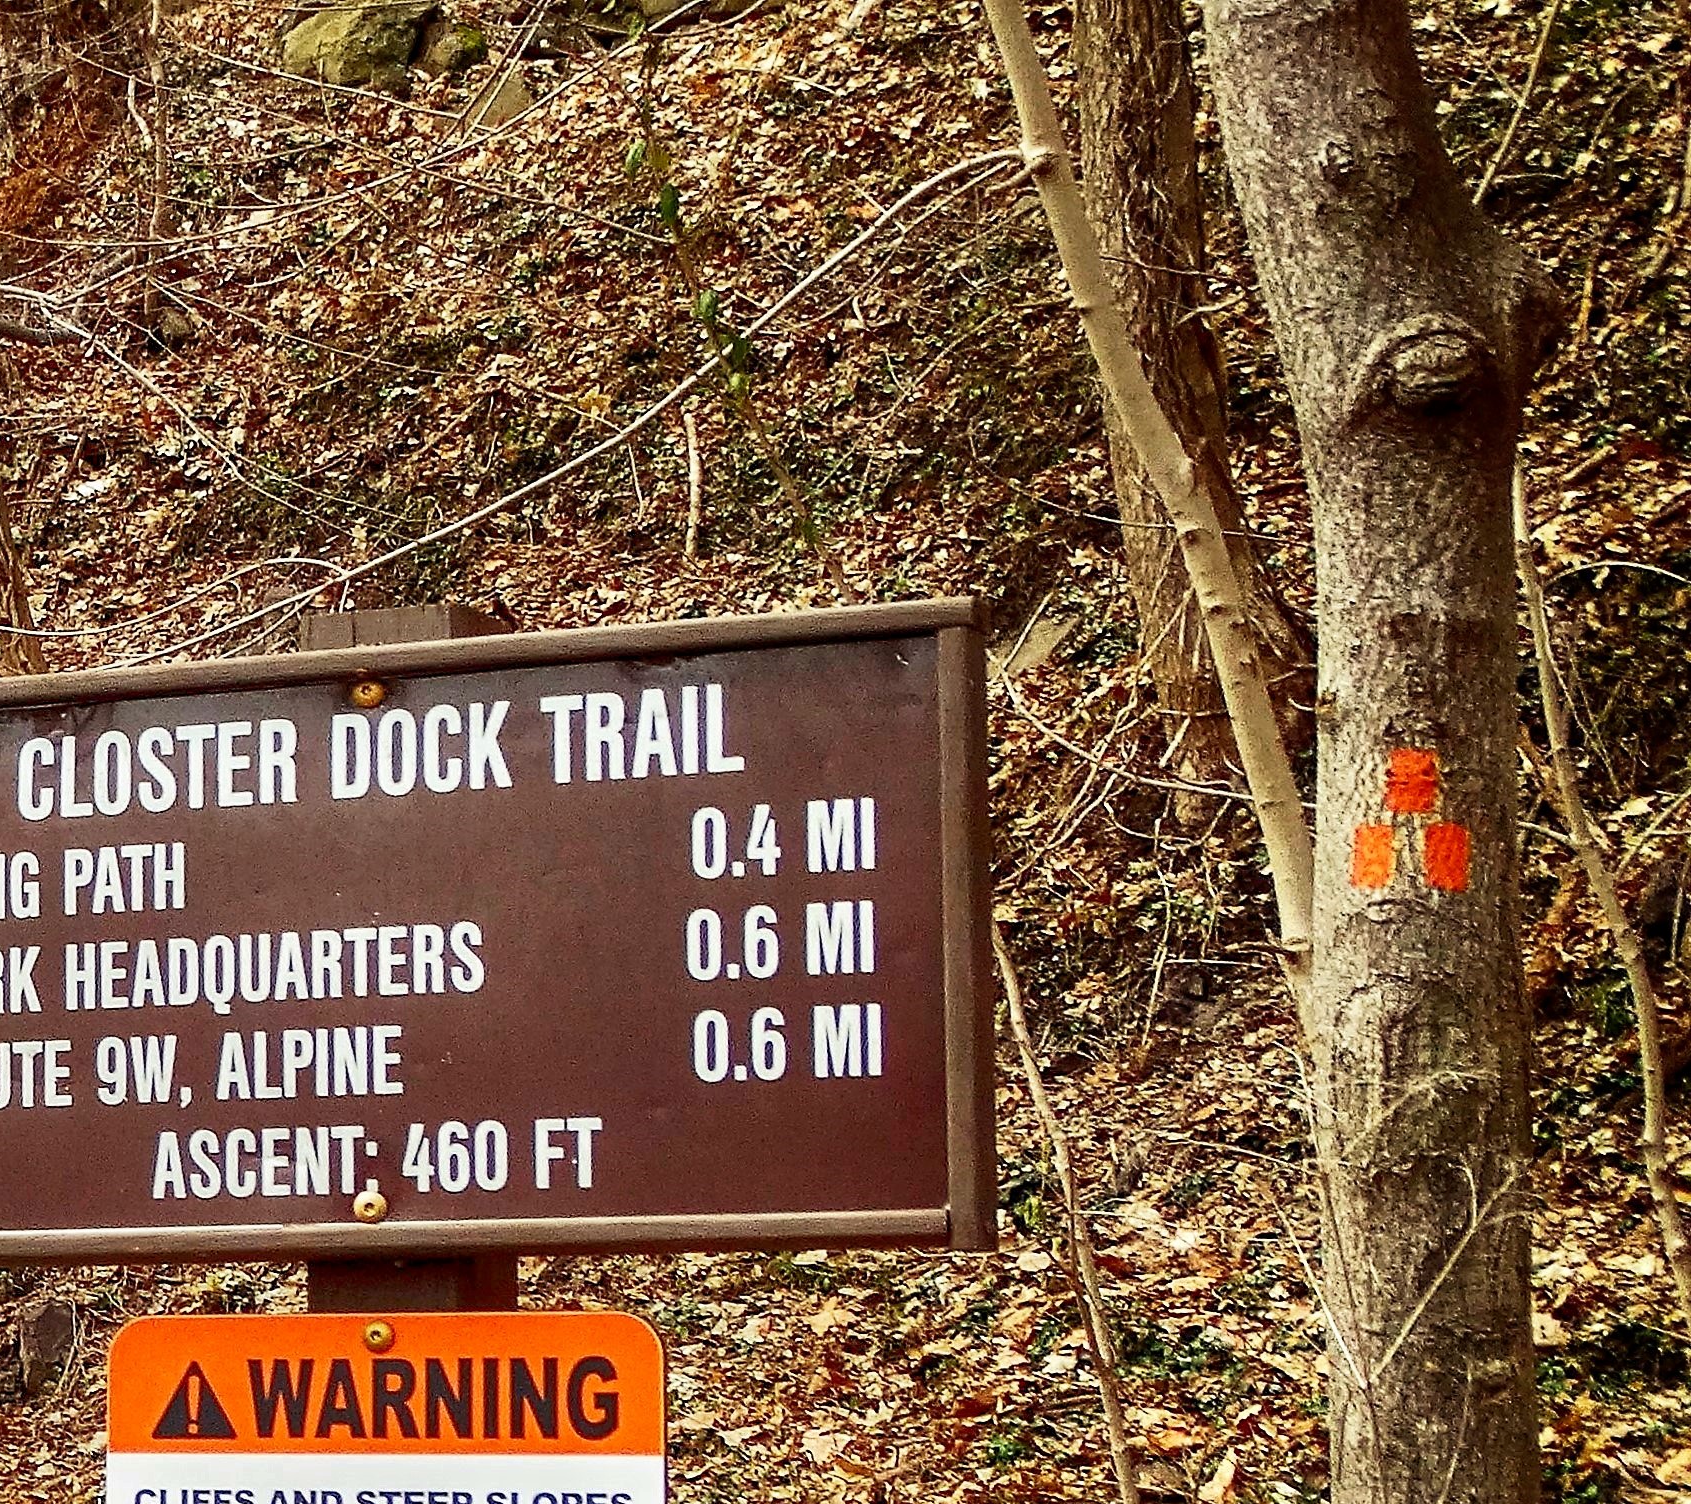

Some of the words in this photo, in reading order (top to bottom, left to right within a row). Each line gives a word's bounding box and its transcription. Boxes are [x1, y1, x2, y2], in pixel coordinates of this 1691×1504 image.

[18, 718, 298, 820] CLOSTER
[331, 701, 512, 799] DOCK
[540, 684, 744, 783] TRAIL
[64, 842, 185, 915] PATH
[692, 804, 781, 879] 0.4
[807, 797, 875, 872] MI
[66, 921, 484, 1014] HEADQUARTERS
[687, 905, 778, 980] 0.6
[806, 900, 874, 975] MI
[97, 1035, 191, 1108] 9W,
[217, 1025, 403, 1100] ALPINE
[694, 1007, 786, 1082] 0.6
[814, 1003, 881, 1077] MI
[153, 1126, 379, 1200] ASCENT:
[403, 1120, 507, 1192] 460
[535, 1117, 602, 1188] FT
[248, 1357, 618, 1439] WARNING
